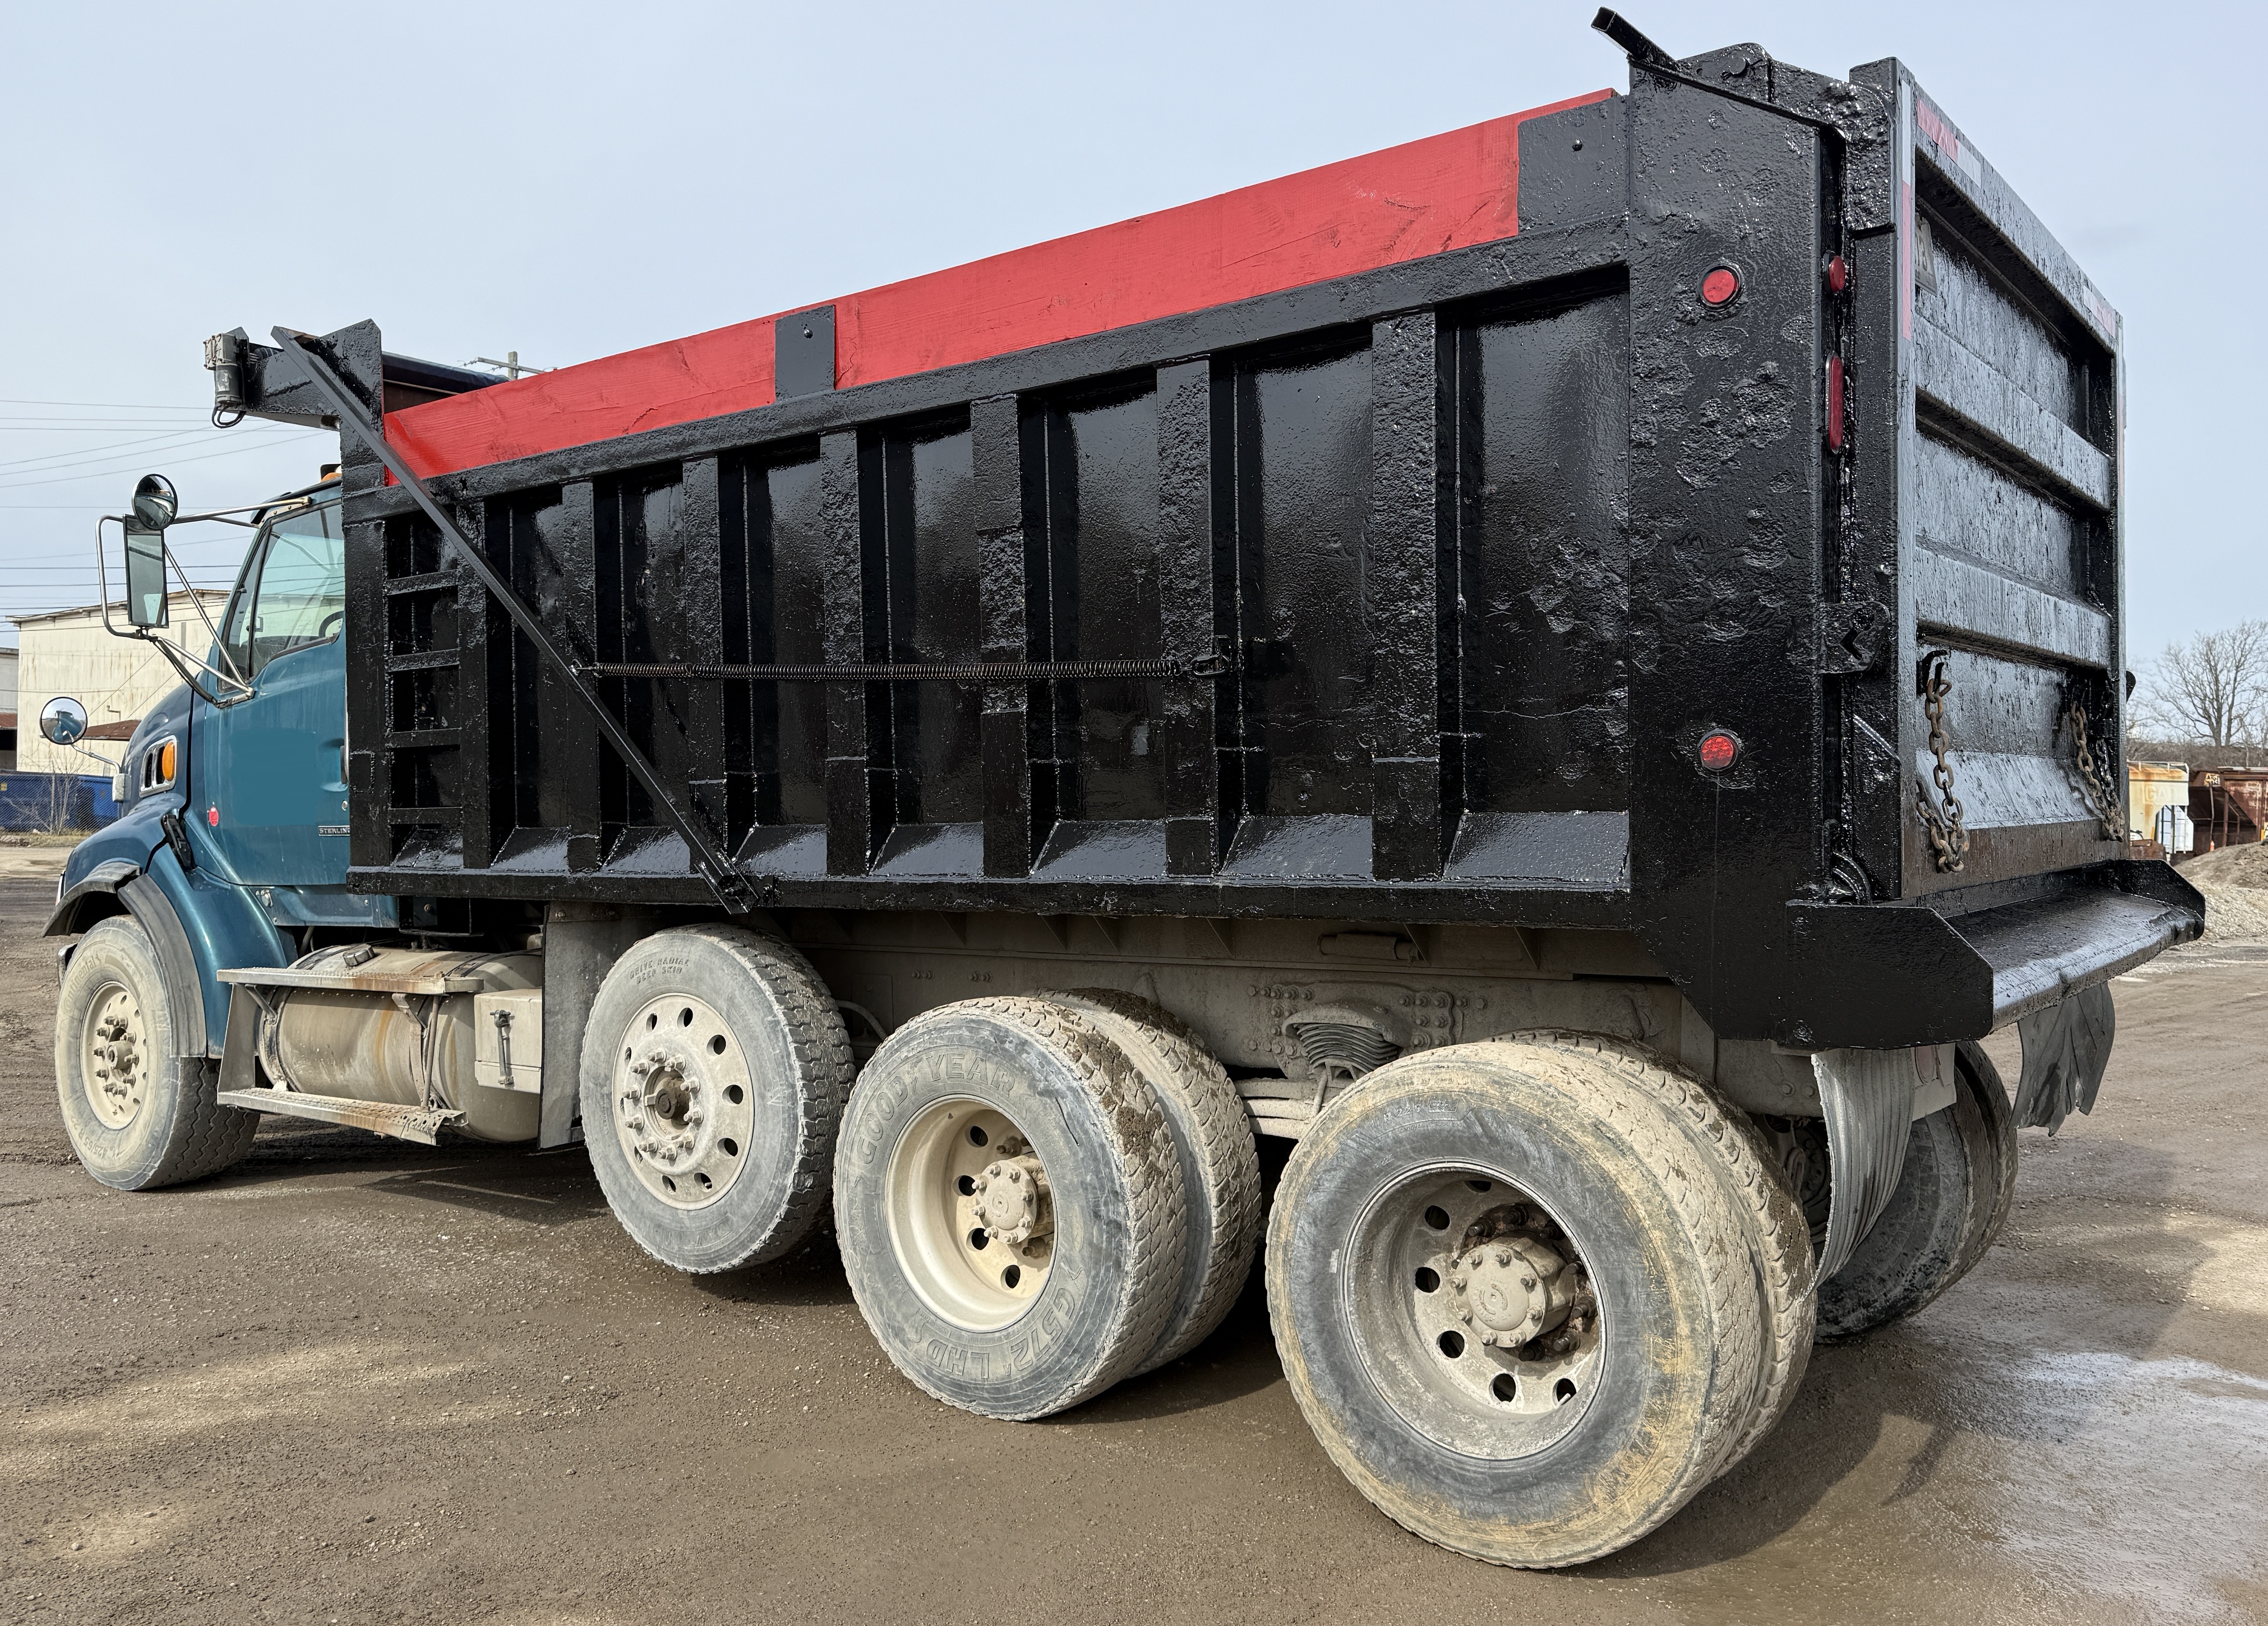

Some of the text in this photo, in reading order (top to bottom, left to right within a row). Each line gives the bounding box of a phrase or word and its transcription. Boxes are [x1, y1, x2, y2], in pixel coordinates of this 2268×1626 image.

[630, 960, 653, 979] DRIVE
[636, 966, 683, 985] DEEP SKID
[926, 1339, 989, 1379] LHD
